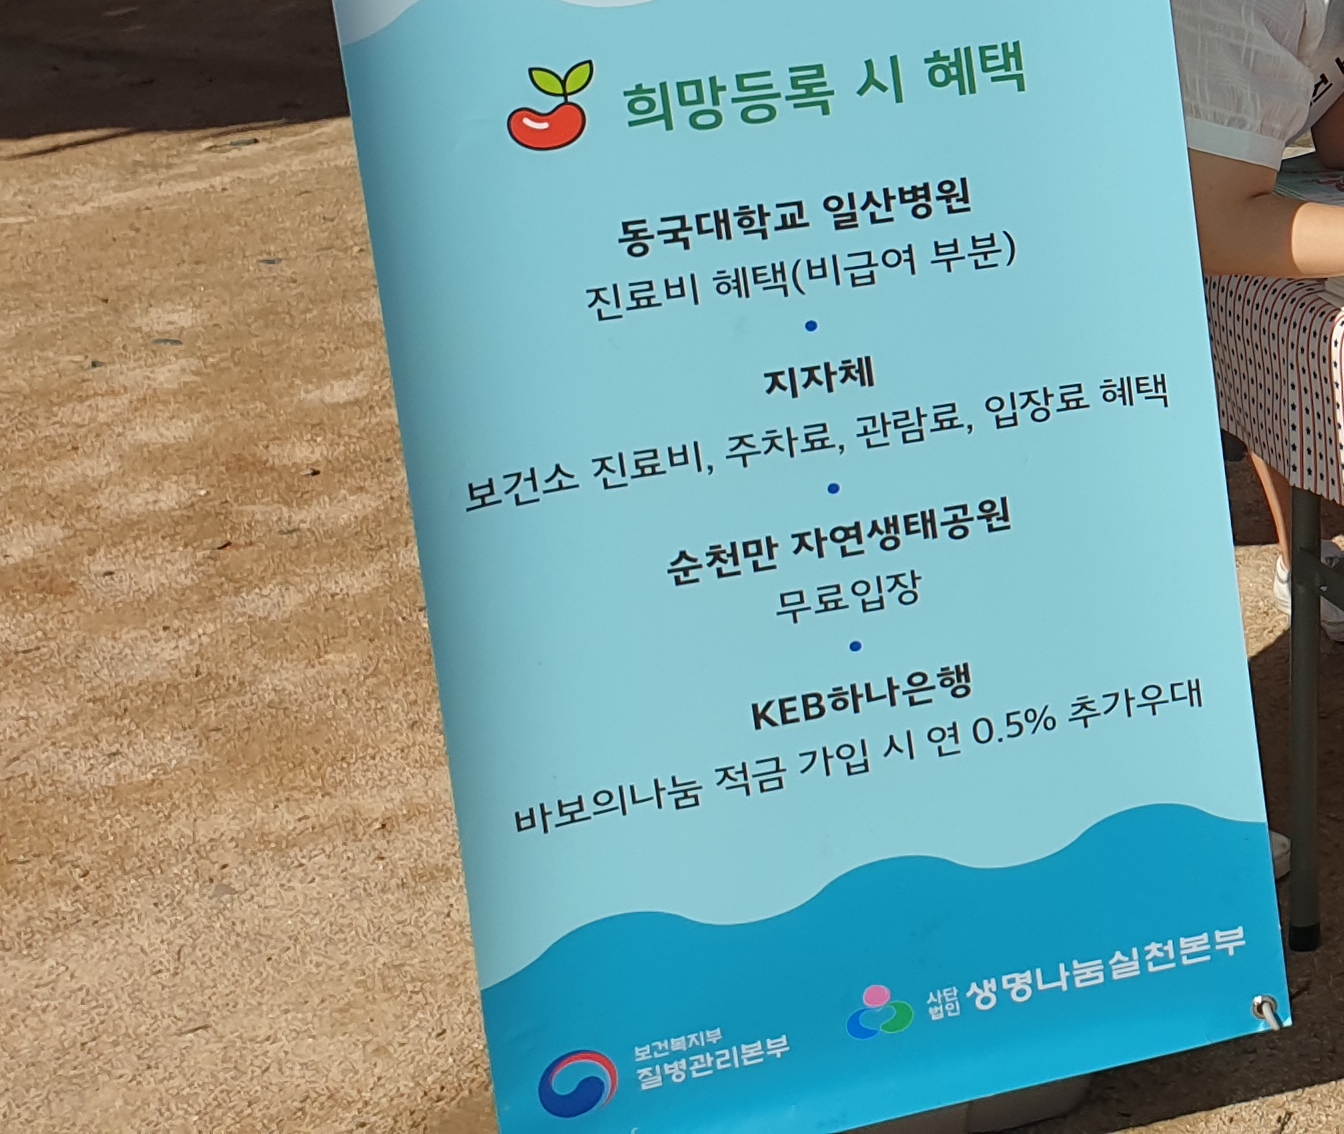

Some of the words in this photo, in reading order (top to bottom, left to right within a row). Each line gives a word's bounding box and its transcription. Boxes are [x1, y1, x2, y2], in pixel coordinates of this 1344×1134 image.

[622, 62, 836, 134] 희망등록
[855, 56, 904, 105] 시
[923, 39, 1028, 100] 혜택
[617, 198, 811, 259] 동국대학교
[821, 176, 973, 232] 일산병원
[586, 274, 701, 324] 진료비
[711, 243, 919, 302] 혜택(비급여
[929, 230, 1019, 276] 부분)
[763, 356, 877, 401] 지자체
[465, 464, 581, 515] 보건소
[590, 440, 714, 492] 진료비,
[725, 420, 846, 472] 주차료,
[854, 401, 973, 455] 관람료,
[984, 382, 1091, 432] 입장료
[1099, 372, 1170, 413] 혜택
[667, 535, 780, 587] 순천만
[790, 496, 1013, 563] 자연생태공원
[775, 570, 924, 625] 무료입장
[751, 662, 975, 732] KEB하나은행
[513, 775, 705, 837] 바보의나눔
[715, 757, 789, 800] 적금
[798, 738, 872, 781] 가입
[882, 729, 917, 765] 시
[925, 721, 963, 759] 연
[971, 706, 1059, 748] 0.5%
[1067, 677, 1205, 729] 추가우대
[927, 986, 959, 1006] 사단
[966, 926, 1247, 1011] 생명나눔실천본부
[634, 1027, 723, 1063] 보건복지부
[928, 1002, 961, 1021] 법인
[637, 1034, 791, 1091] 질병관리본부
